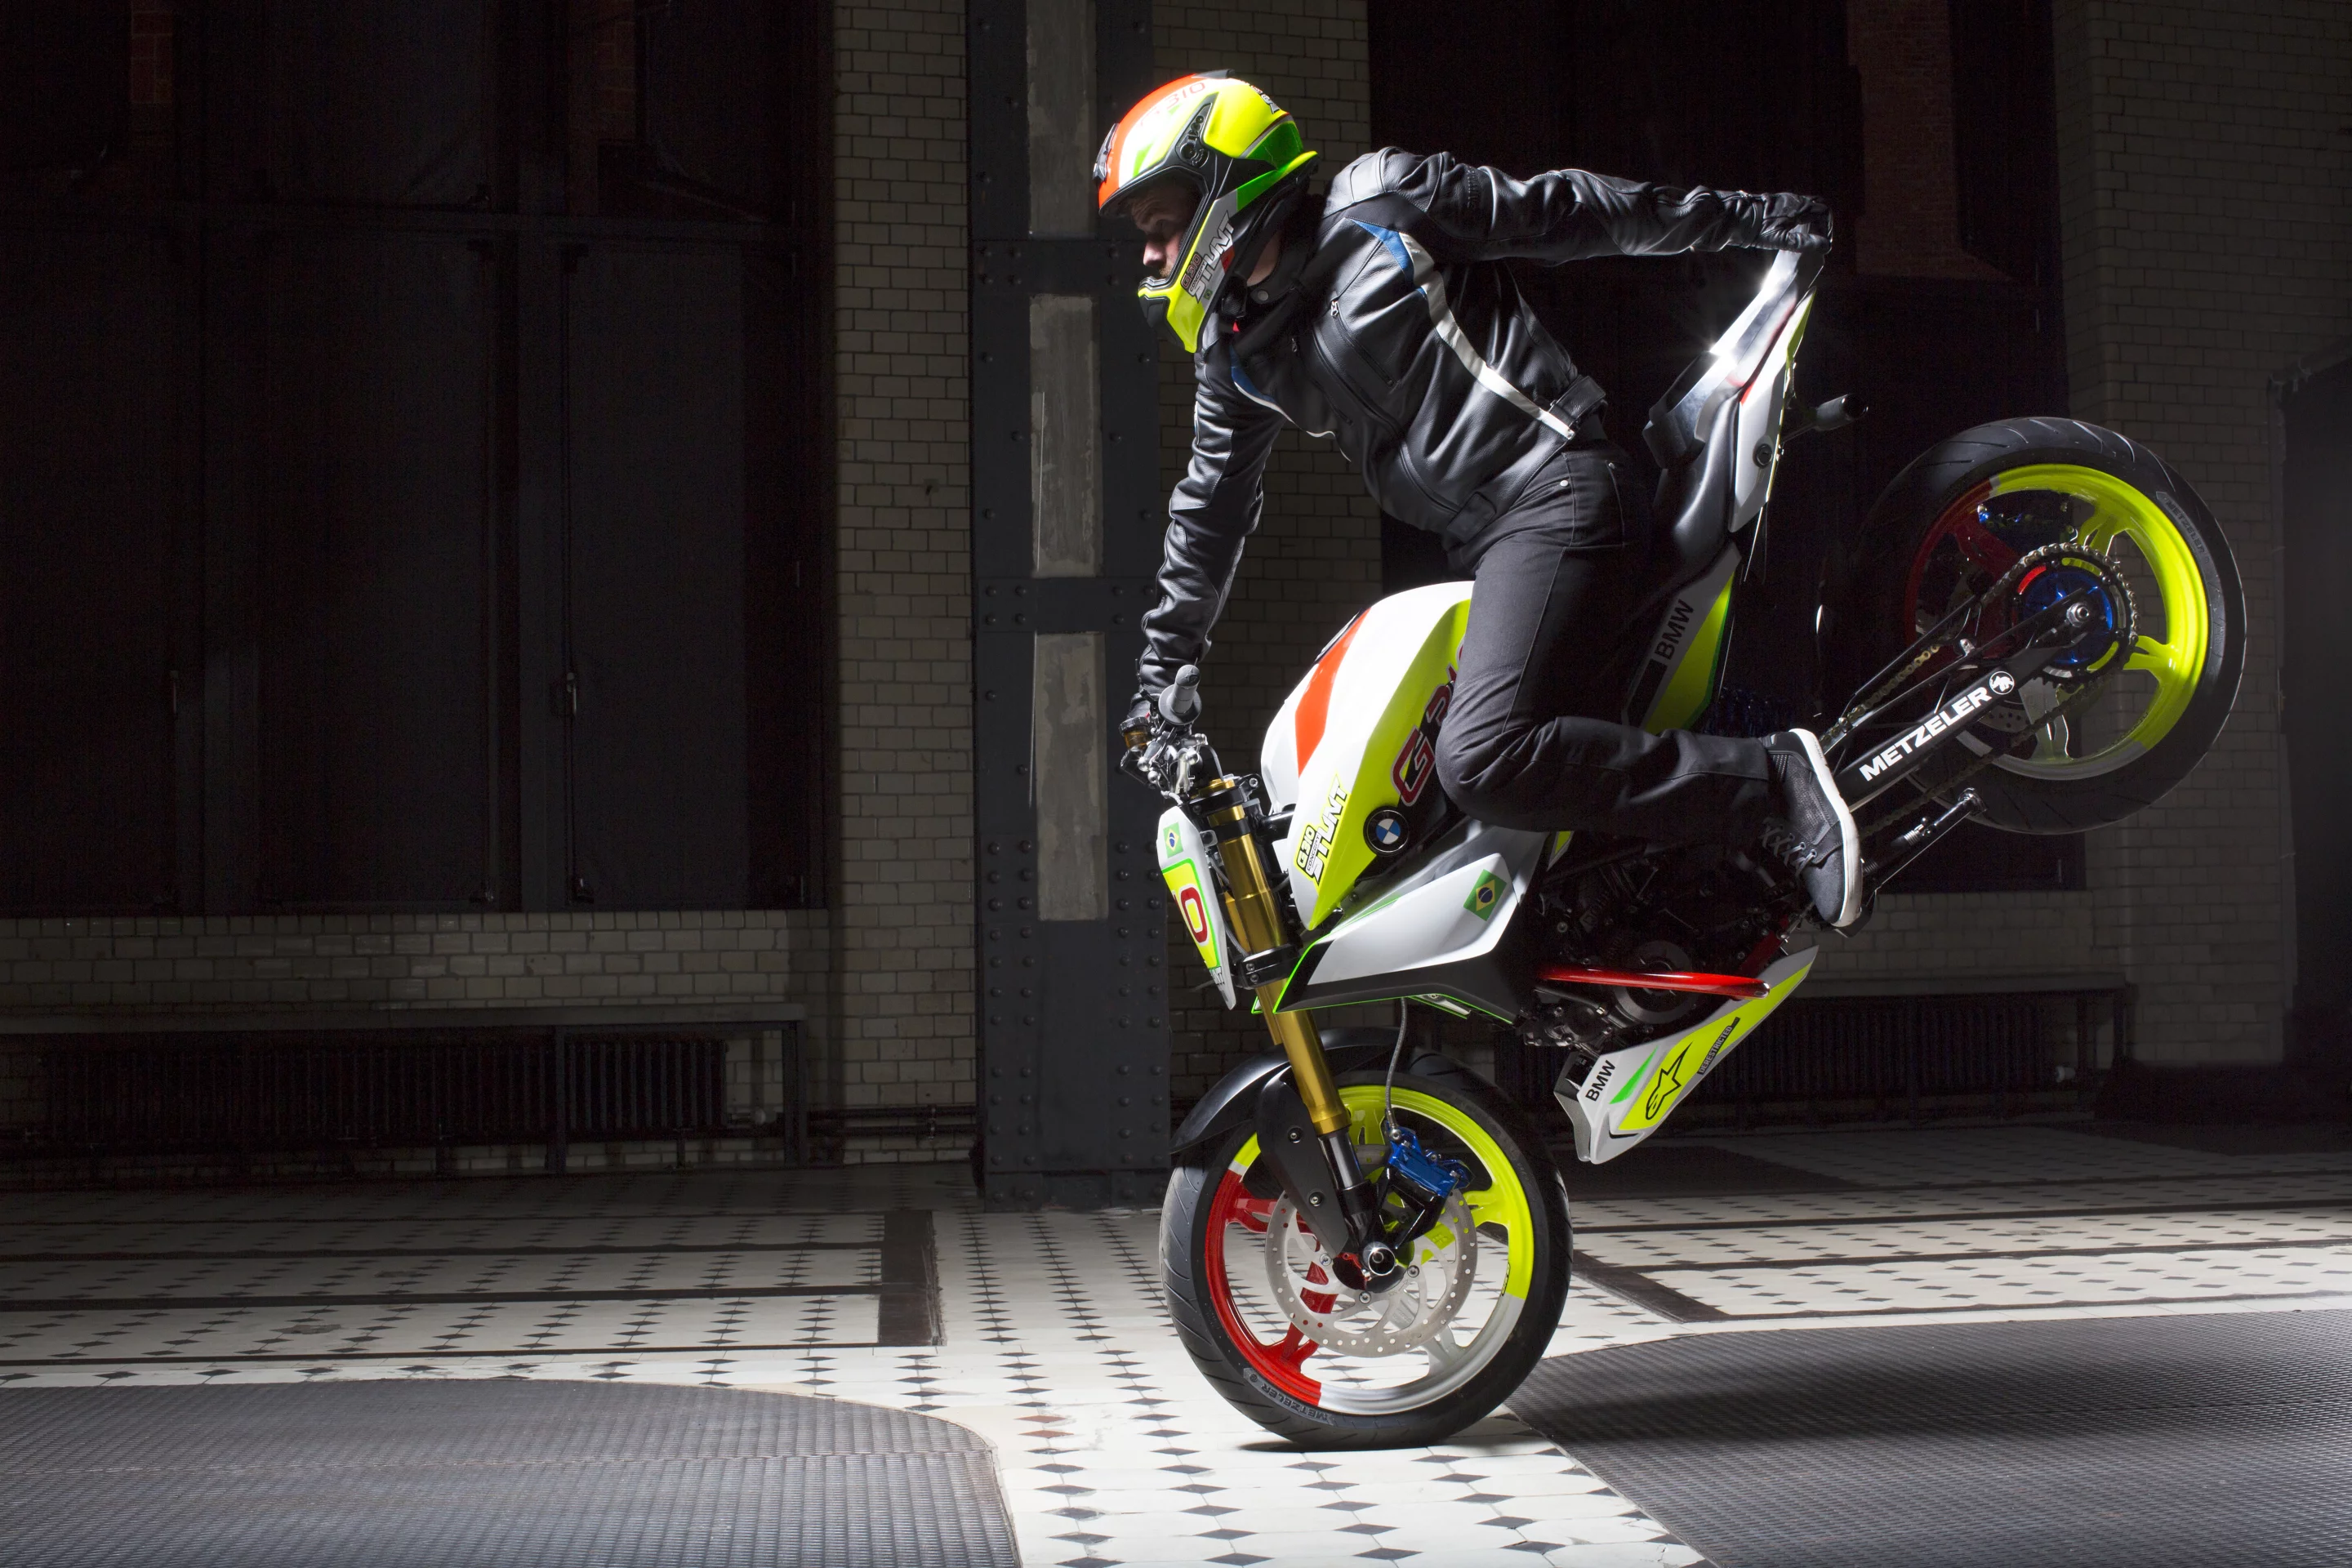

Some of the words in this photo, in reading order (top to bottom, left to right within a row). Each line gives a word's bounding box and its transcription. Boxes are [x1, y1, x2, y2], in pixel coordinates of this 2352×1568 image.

[1181, 252, 1202, 290] G310
[1189, 261, 1208, 292] CONCEPT
[1194, 210, 1234, 303] STUNT
[2165, 499, 2205, 553] METZELER
[1654, 599, 1694, 660] BMW
[1859, 687, 1993, 782] METZELER
[1297, 824, 1316, 869] G310
[1307, 835, 1320, 871] CONCEPT
[1313, 773, 1348, 886] STUNT
[1698, 1025, 1733, 1074] DERESTRICTED
[1585, 1060, 1615, 1102] BMW
[1261, 1383, 1329, 1421] METZELER
